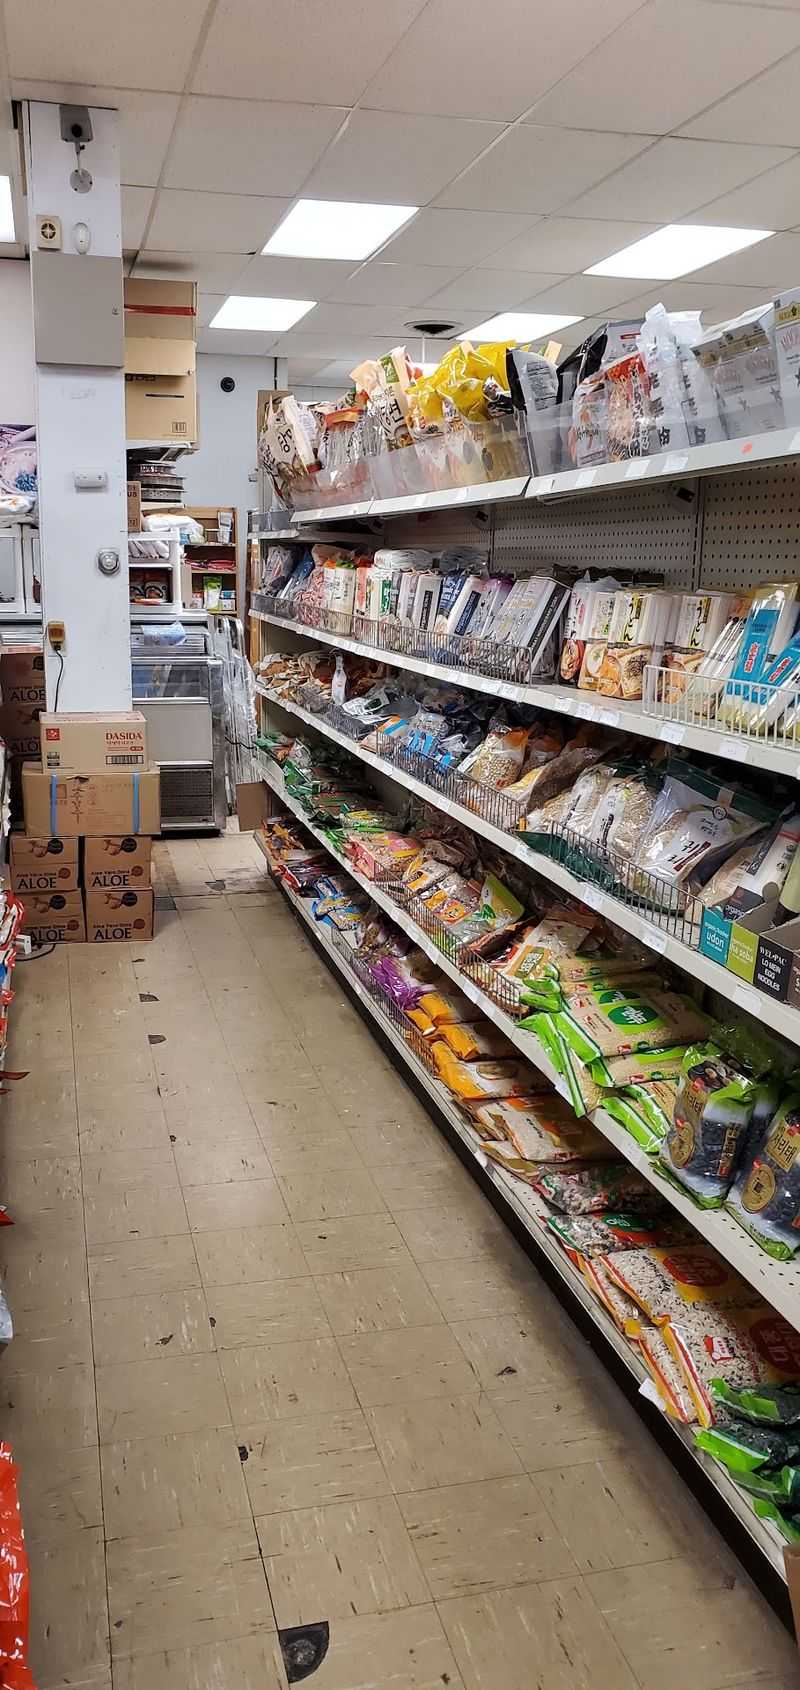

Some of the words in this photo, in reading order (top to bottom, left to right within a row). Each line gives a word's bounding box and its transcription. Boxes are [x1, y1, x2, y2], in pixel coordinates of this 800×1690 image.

[105, 731, 143, 741] DASIDA
[17, 877, 57, 890] ALOE
[92, 874, 129, 887] ALOE
[94, 927, 132, 941] ALOE
[706, 931, 724, 948] udon
[764, 967, 776, 980] EGG
[757, 972, 781, 992] NOODLES
